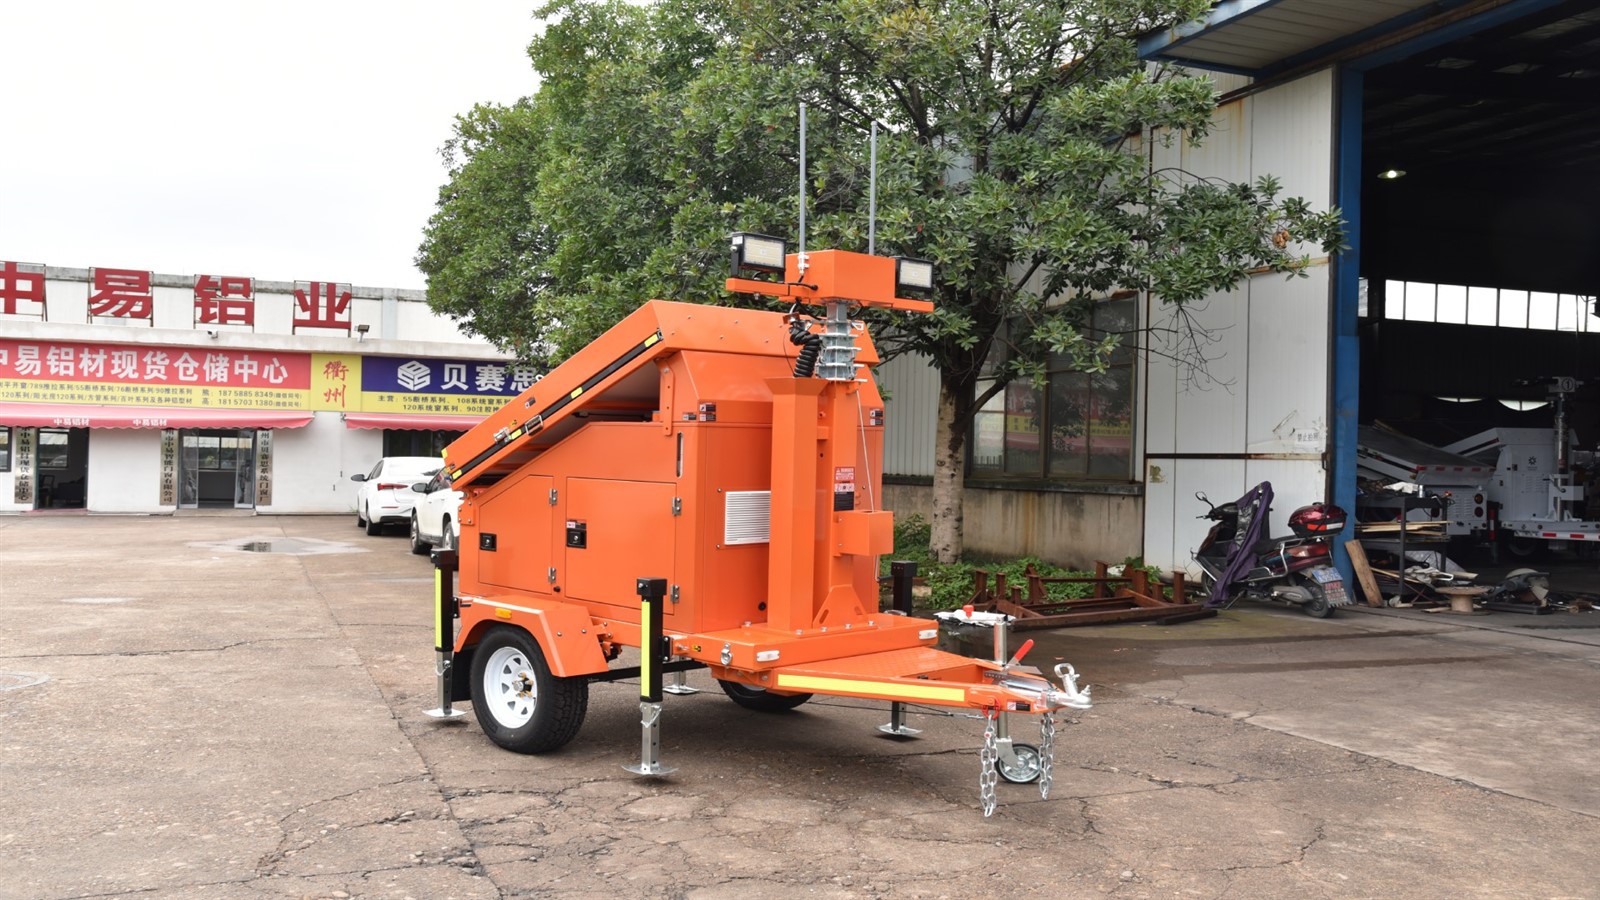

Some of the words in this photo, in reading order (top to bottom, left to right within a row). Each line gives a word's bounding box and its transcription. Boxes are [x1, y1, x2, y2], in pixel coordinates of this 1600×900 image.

[0, 261, 352, 329] 中易铝业
[323, 360, 349, 408] 衢州
